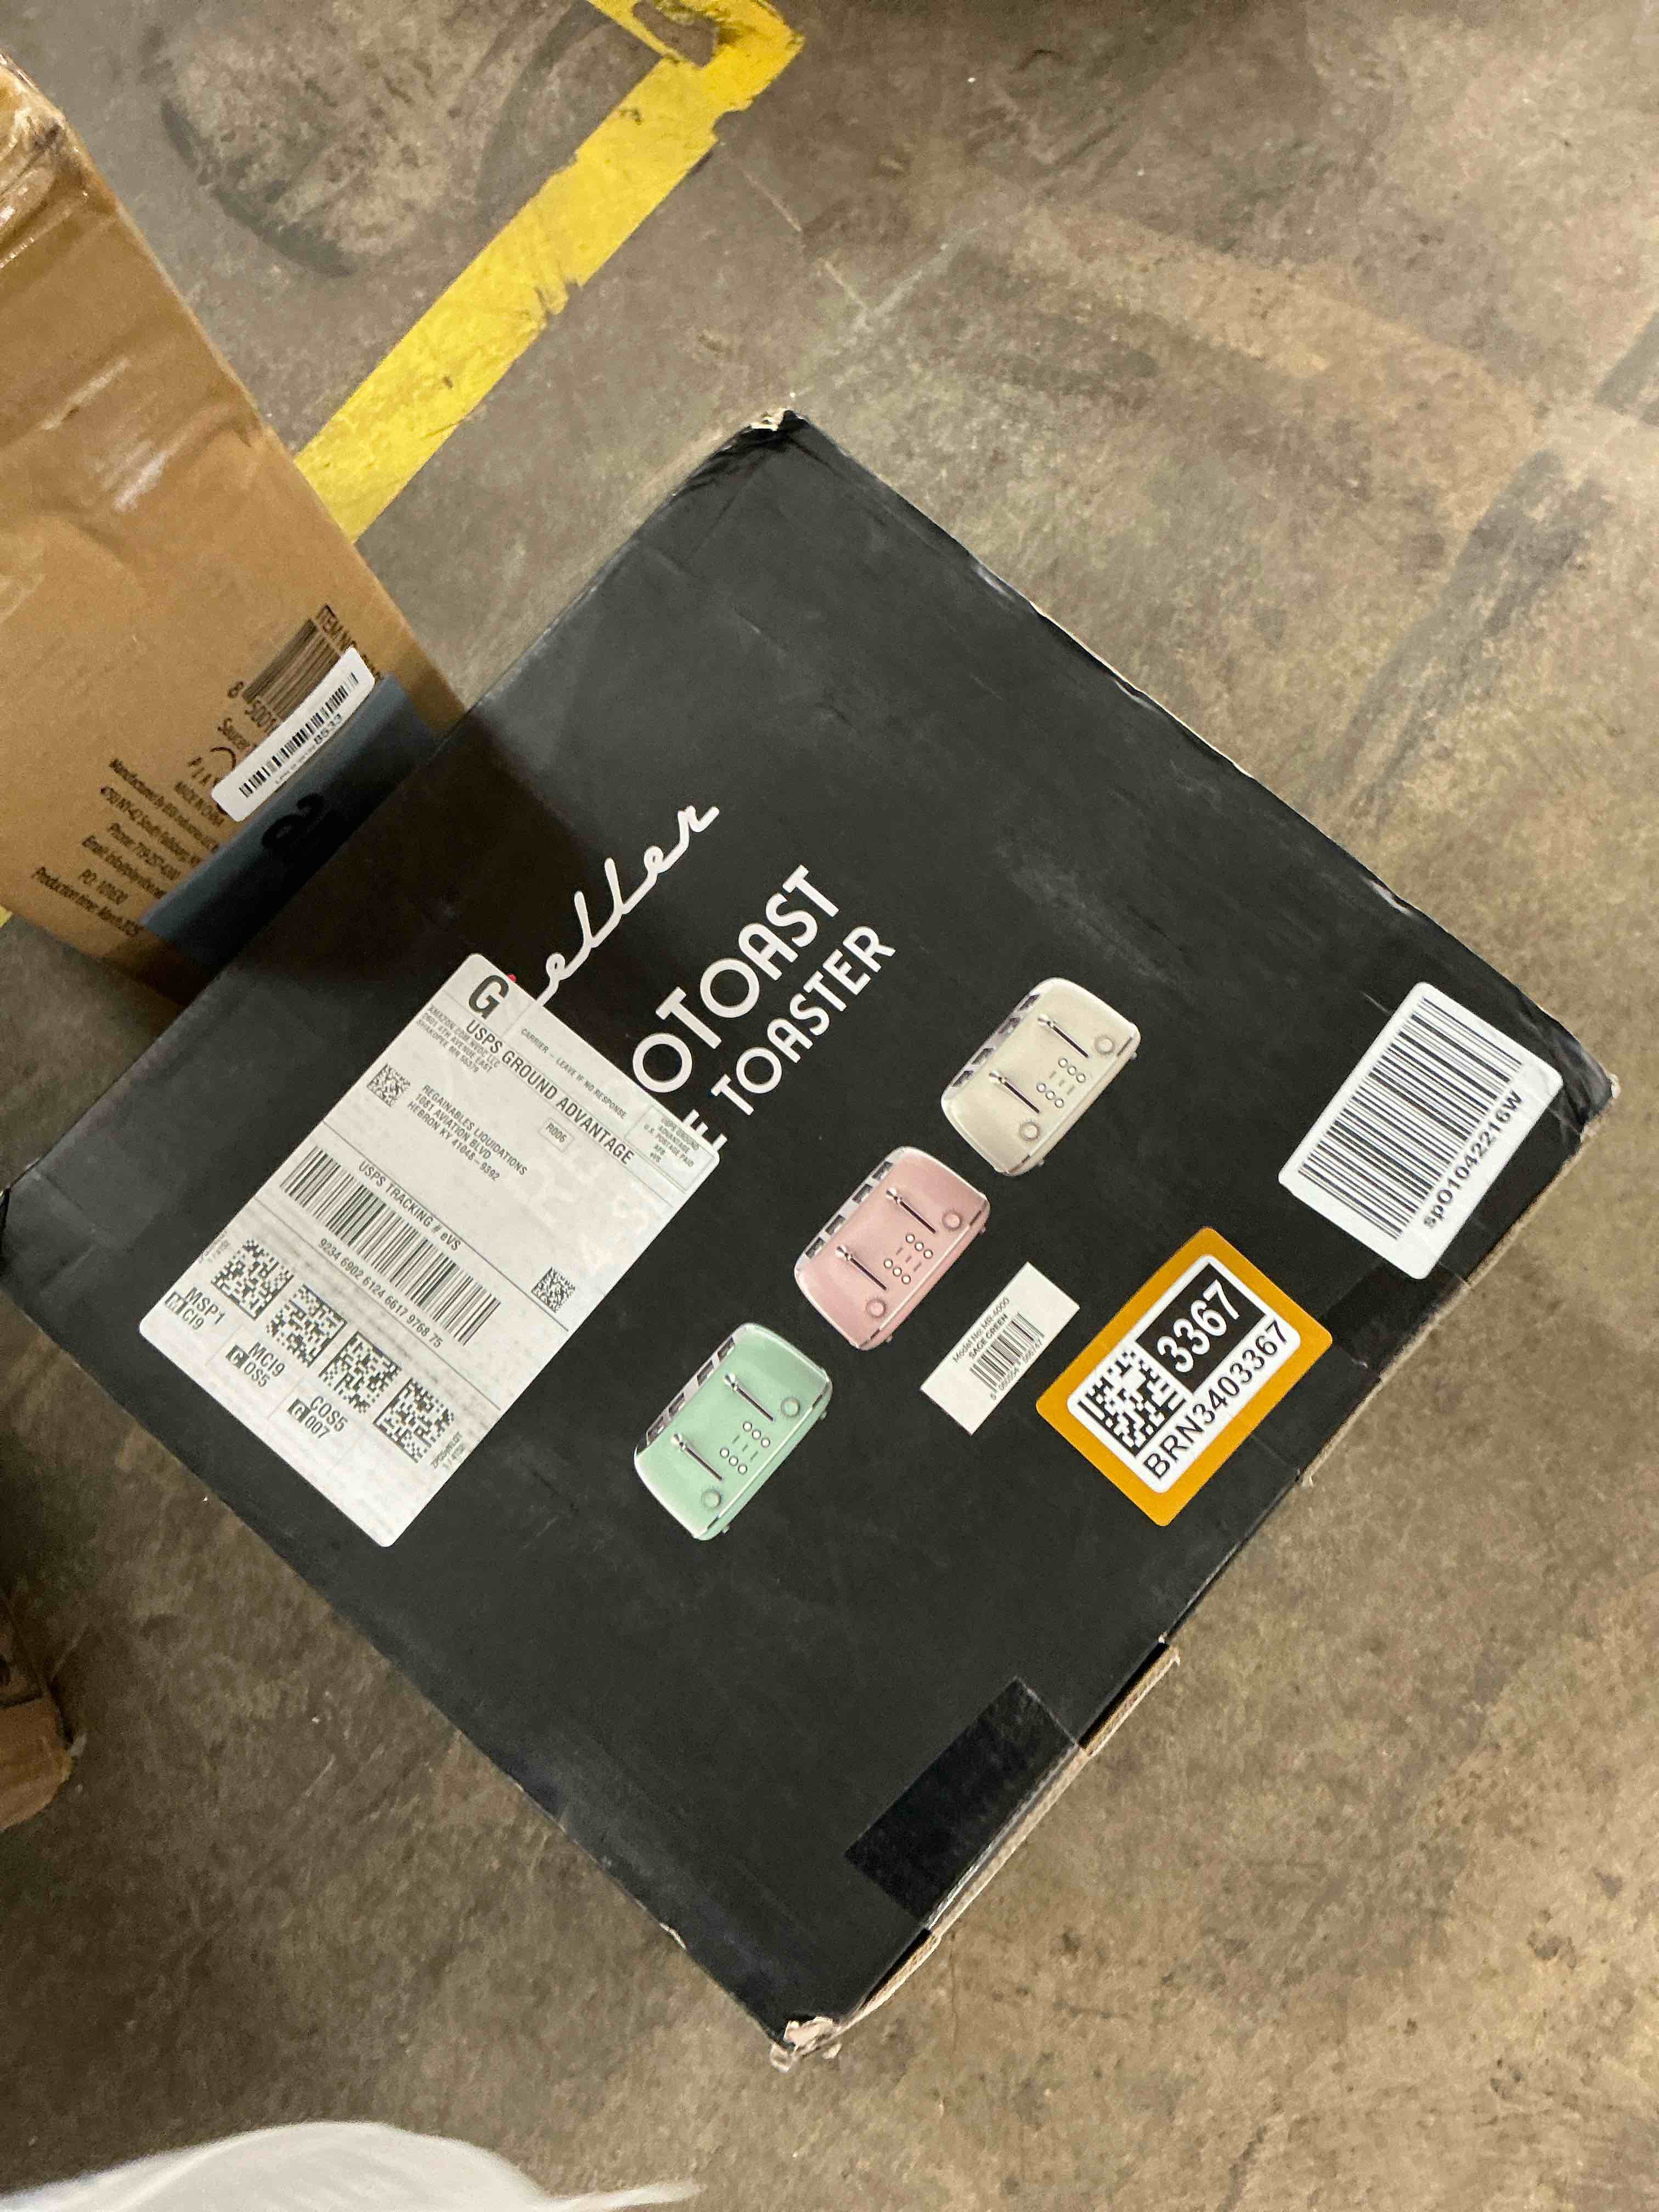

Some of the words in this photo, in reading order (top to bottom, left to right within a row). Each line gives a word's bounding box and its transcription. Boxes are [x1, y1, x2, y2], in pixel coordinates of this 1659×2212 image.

[314, 602, 345, 640] ITEM
[225, 677, 246, 702] 8
[245, 697, 281, 738] 5001
[538, 805, 720, 1006] eller
[469, 975, 509, 1019] G
[633, 865, 839, 1092] OTOAST
[415, 1018, 449, 1048] SHAKOPEE
[711, 927, 895, 1115] TOASTER
[450, 1035, 476, 1059] AVENUE
[474, 1056, 493, 1074] EAST
[486, 1054, 500, 1069] LLC
[521, 1029, 549, 1053] CARRIER
[556, 1058, 577, 1076] LEAVE
[575, 1074, 585, 1083] IF
[584, 1081, 594, 1091] NO
[594, 1089, 626, 1119] RESPONSE
[408, 1102, 440, 1130] HEBRON
[439, 1128, 452, 1139] KY
[466, 1019, 503, 1053] USPS
[502, 1051, 557, 1099] GROUND
[556, 1097, 634, 1164] ADVANTAGE
[416, 1094, 434, 1111] 1081
[434, 1109, 470, 1141] AVIATION
[470, 1139, 491, 1159] BLVD
[422, 1085, 475, 1130] REGAINABLES
[474, 1128, 527, 1175] LIQUIDATIONS
[359, 1161, 386, 1186] USPS
[386, 1183, 436, 1227] TRACKING
[431, 1223, 442, 1234] #
[441, 1233, 461, 1250] eVS
[182, 1287, 225, 1324] MSP1
[319, 1238, 341, 1260] 9234
[341, 1257, 364, 1279] 6902
[363, 1277, 386, 1298] 6124
[385, 1296, 408, 1316] 6617
[407, 1314, 430, 1336] 9768
[430, 1333, 443, 1347] 75
[951, 1338, 974, 1363] Model
[967, 1336, 988, 1359] SAGE
[984, 1312, 1009, 1340] GREEN
[1156, 1280, 1241, 1372] 3367
[246, 1342, 285, 1376] MCI9
[306, 1396, 348, 1431] COS5
[1143, 1320, 1286, 1479] BRN3403367
